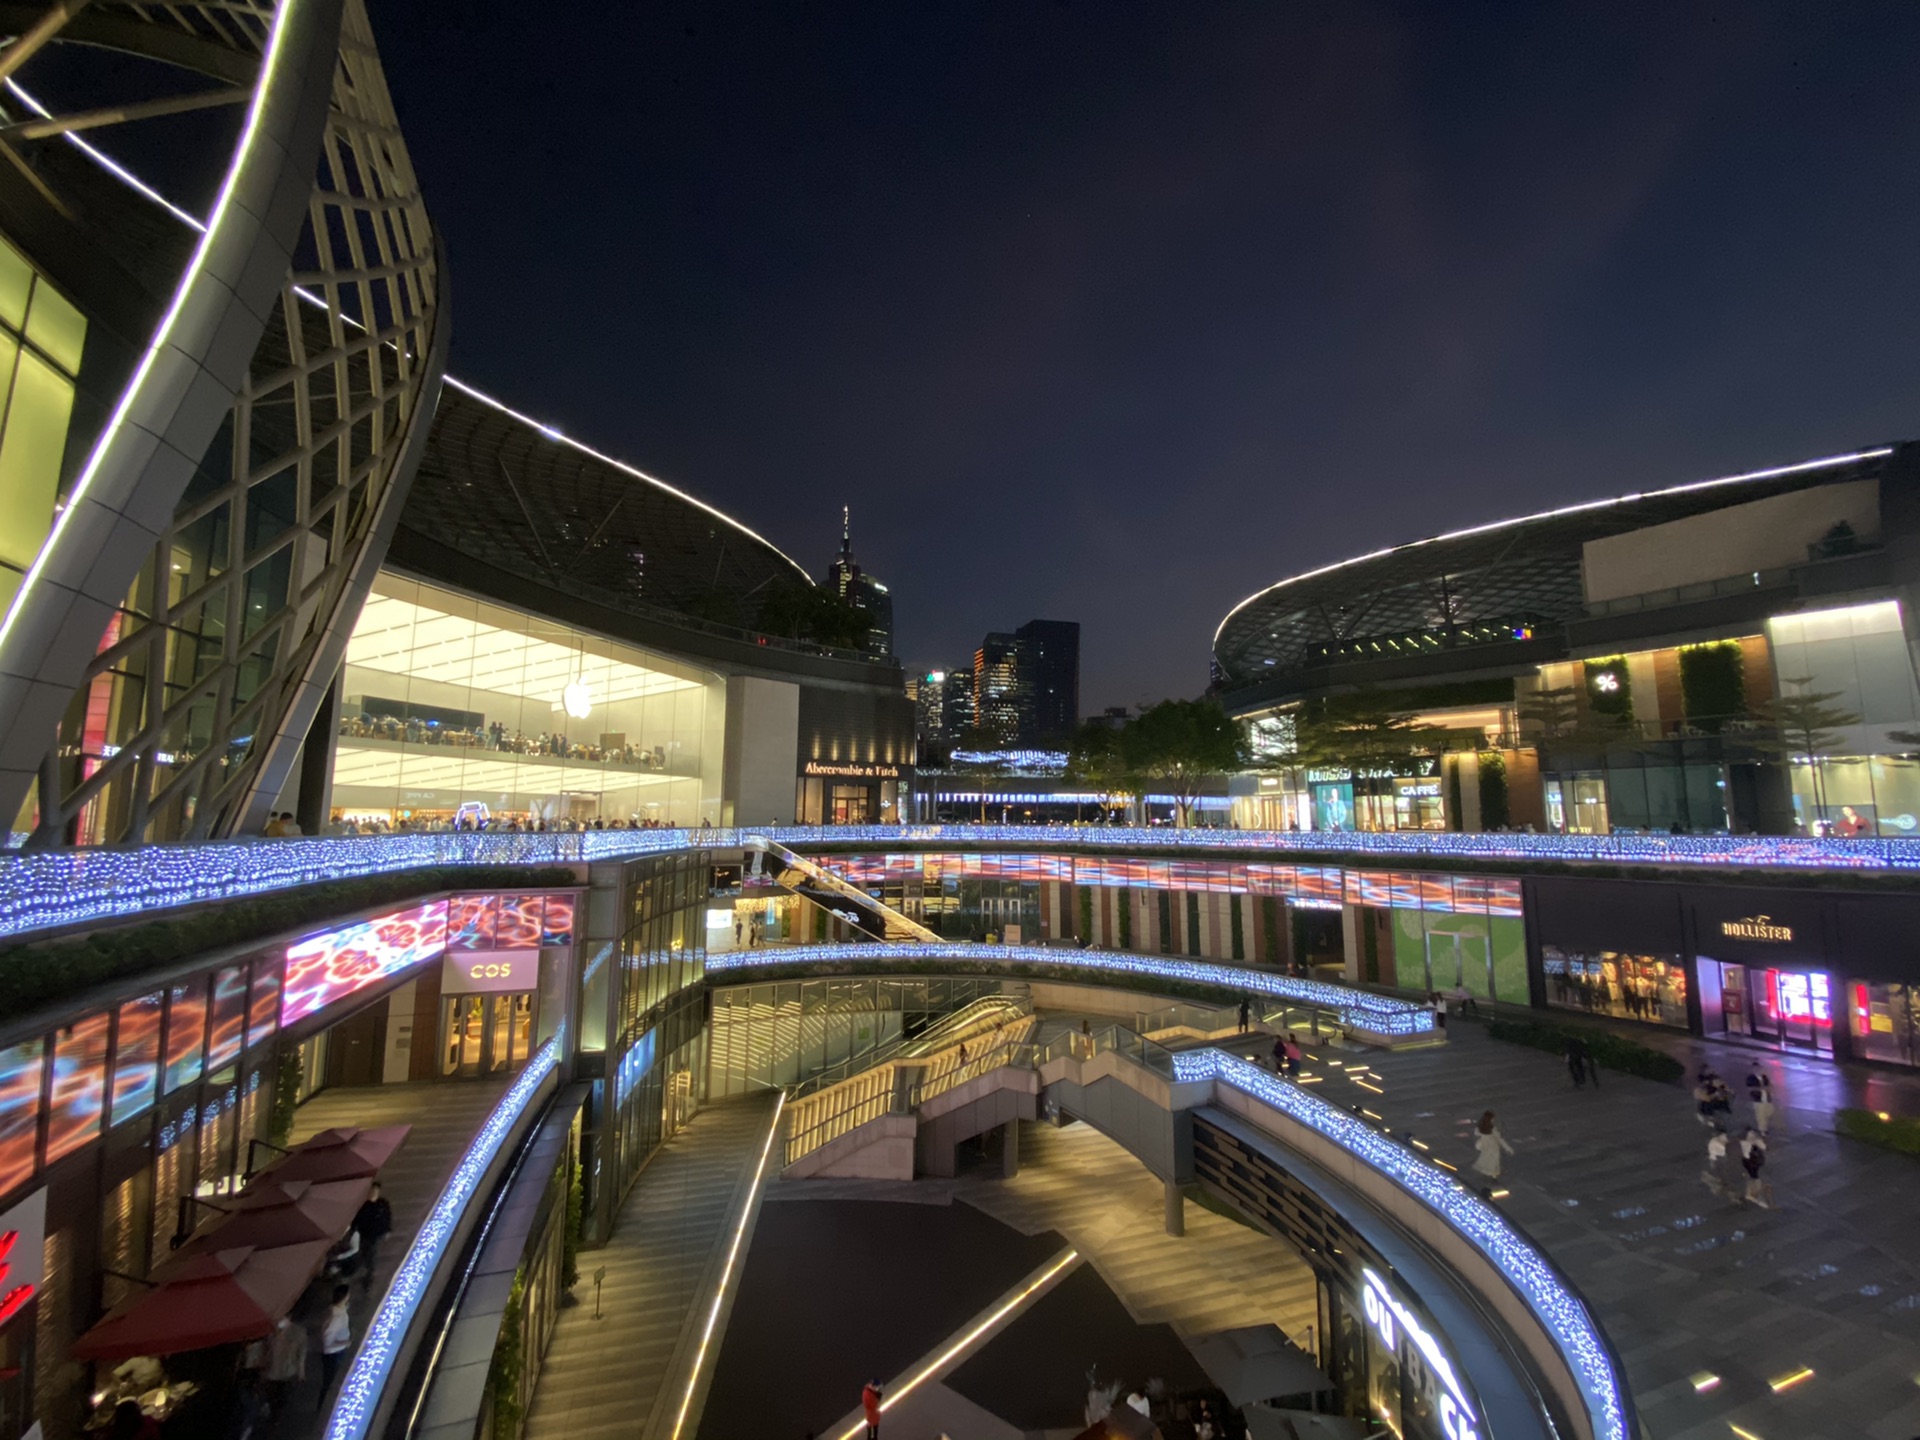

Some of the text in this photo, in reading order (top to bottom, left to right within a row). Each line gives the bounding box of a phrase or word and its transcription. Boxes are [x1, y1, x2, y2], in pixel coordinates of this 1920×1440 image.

[805, 762, 898, 777] Abercrombie & Fitch
[1722, 922, 1791, 941] HOLLISTER
[470, 963, 512, 978] COS
